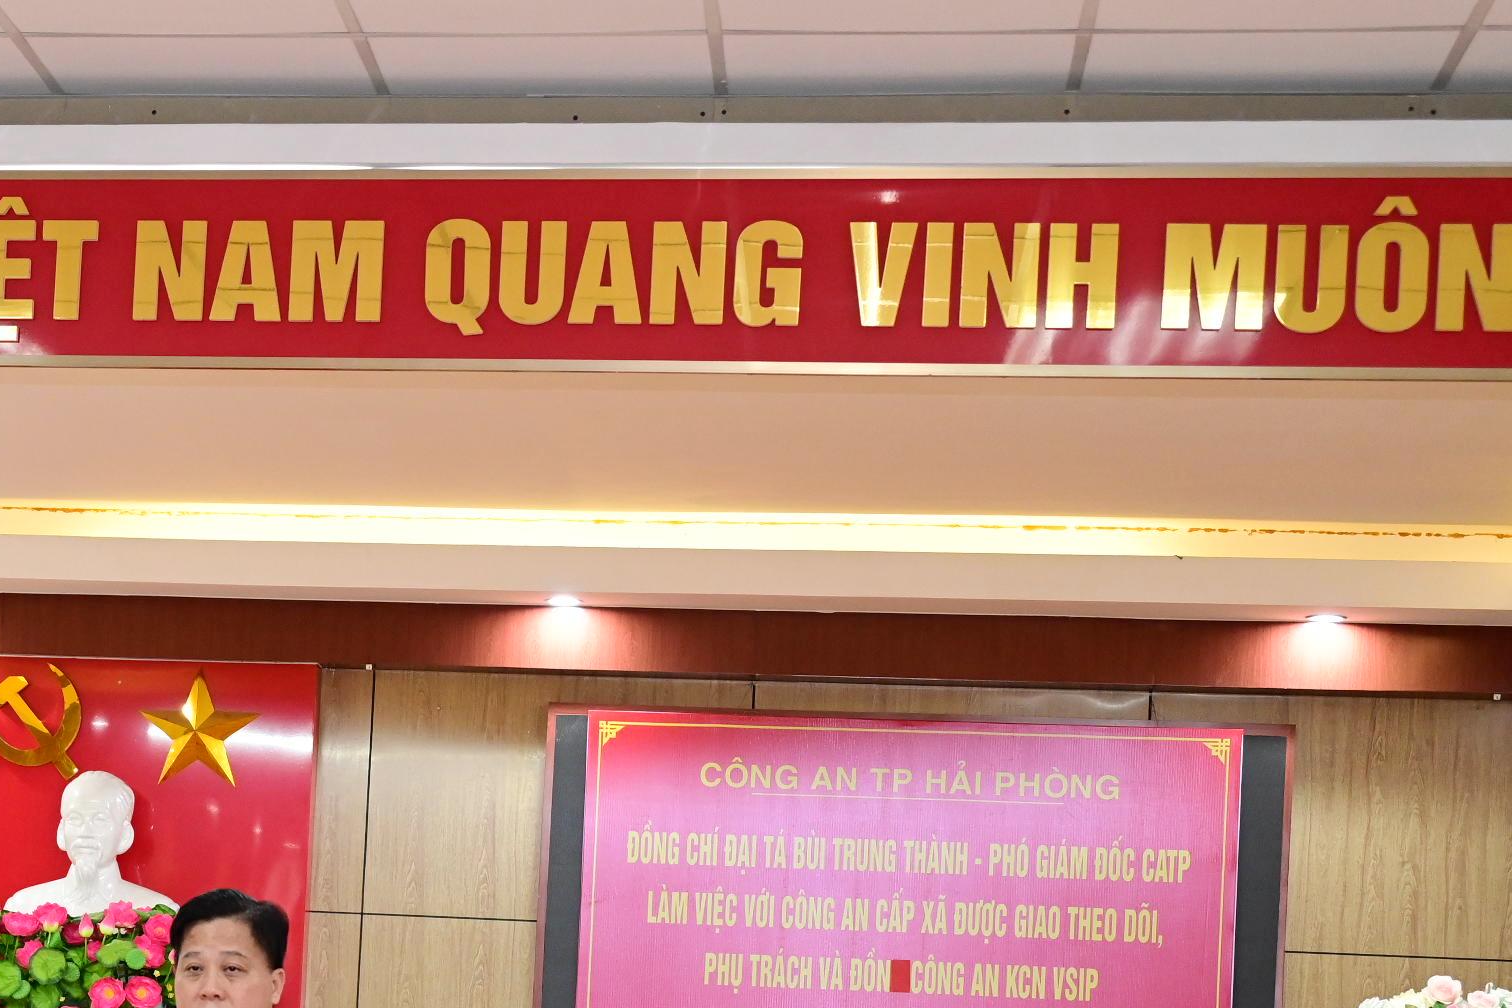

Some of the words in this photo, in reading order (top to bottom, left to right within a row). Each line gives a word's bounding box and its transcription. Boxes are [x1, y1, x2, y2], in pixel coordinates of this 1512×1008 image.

[132, 219, 385, 323] NAM
[424, 218, 804, 336] QUANG
[849, 220, 1120, 331] VINH
[1160, 196, 1512, 334] MUÔN
[700, 757, 798, 790] CÔNG
[811, 766, 857, 791] AN
[870, 768, 913, 793] TP
[925, 760, 981, 795] HẢI
[995, 767, 1120, 800] PHÒNG
[627, 820, 680, 865] ĐỒNG
[686, 826, 719, 866] CHÍ
[724, 834, 757, 875] ĐẠI
[764, 829, 787, 869] TÁ
[793, 829, 826, 870] BÙI
[833, 837, 897, 873] TRUNG
[903, 833, 968, 875] THÀNH
[988, 837, 1029, 877] PHÓ
[1036, 839, 1088, 880] GIÁM
[1095, 835, 1135, 881] ĐỐC
[1142, 848, 1191, 883] CATP
[647, 884, 689, 925] LÀM
[695, 886, 737, 933] VIỆC
[744, 888, 775, 928] VỚI
[781, 889, 835, 930] CÔNG
[841, 897, 870, 931] AN
[875, 888, 914, 933] CẤP
[921, 895, 948, 935] XÃ
[954, 900, 1007, 944] ĐƯỢC
[1014, 904, 1061, 940] GIAO
[1068, 907, 1117, 942] THEO
[1123, 903, 1163, 948] DÕI,
[704, 952, 744, 994] PHỤ
[750, 948, 812, 990] TRÁCH
[819, 950, 843, 991] VÀ
[911, 954, 964, 996] CÔNG
[971, 963, 1000, 997] AN
[1005, 965, 1046, 999] KCN
[1053, 967, 1099, 1001] VSIP
